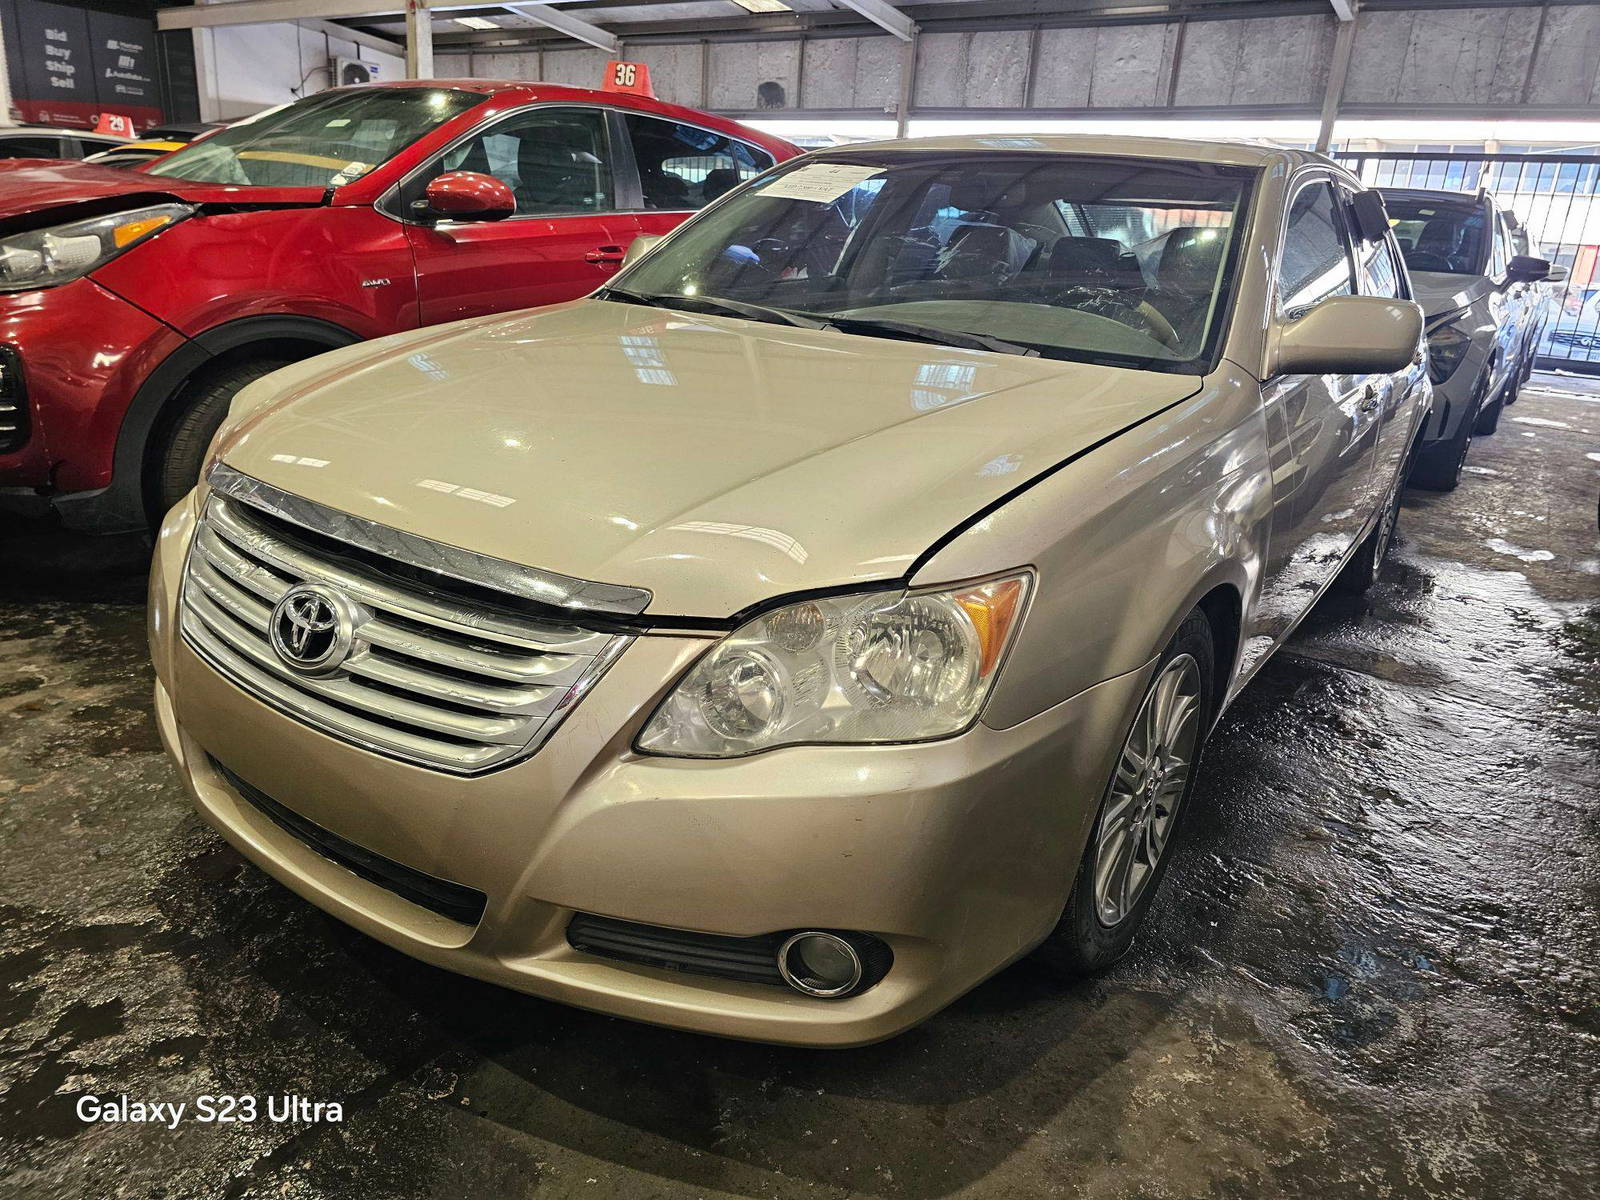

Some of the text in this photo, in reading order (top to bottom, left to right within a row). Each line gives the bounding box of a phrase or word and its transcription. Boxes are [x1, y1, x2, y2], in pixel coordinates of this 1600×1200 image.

[45, 29, 67, 41] Bid
[45, 45, 71, 60] Buy
[45, 61, 75, 76] Ship
[615, 63, 636, 87] 36
[50, 76, 75, 89] Sell
[109, 116, 125, 131] 29
[362, 278, 391, 287] AWD
